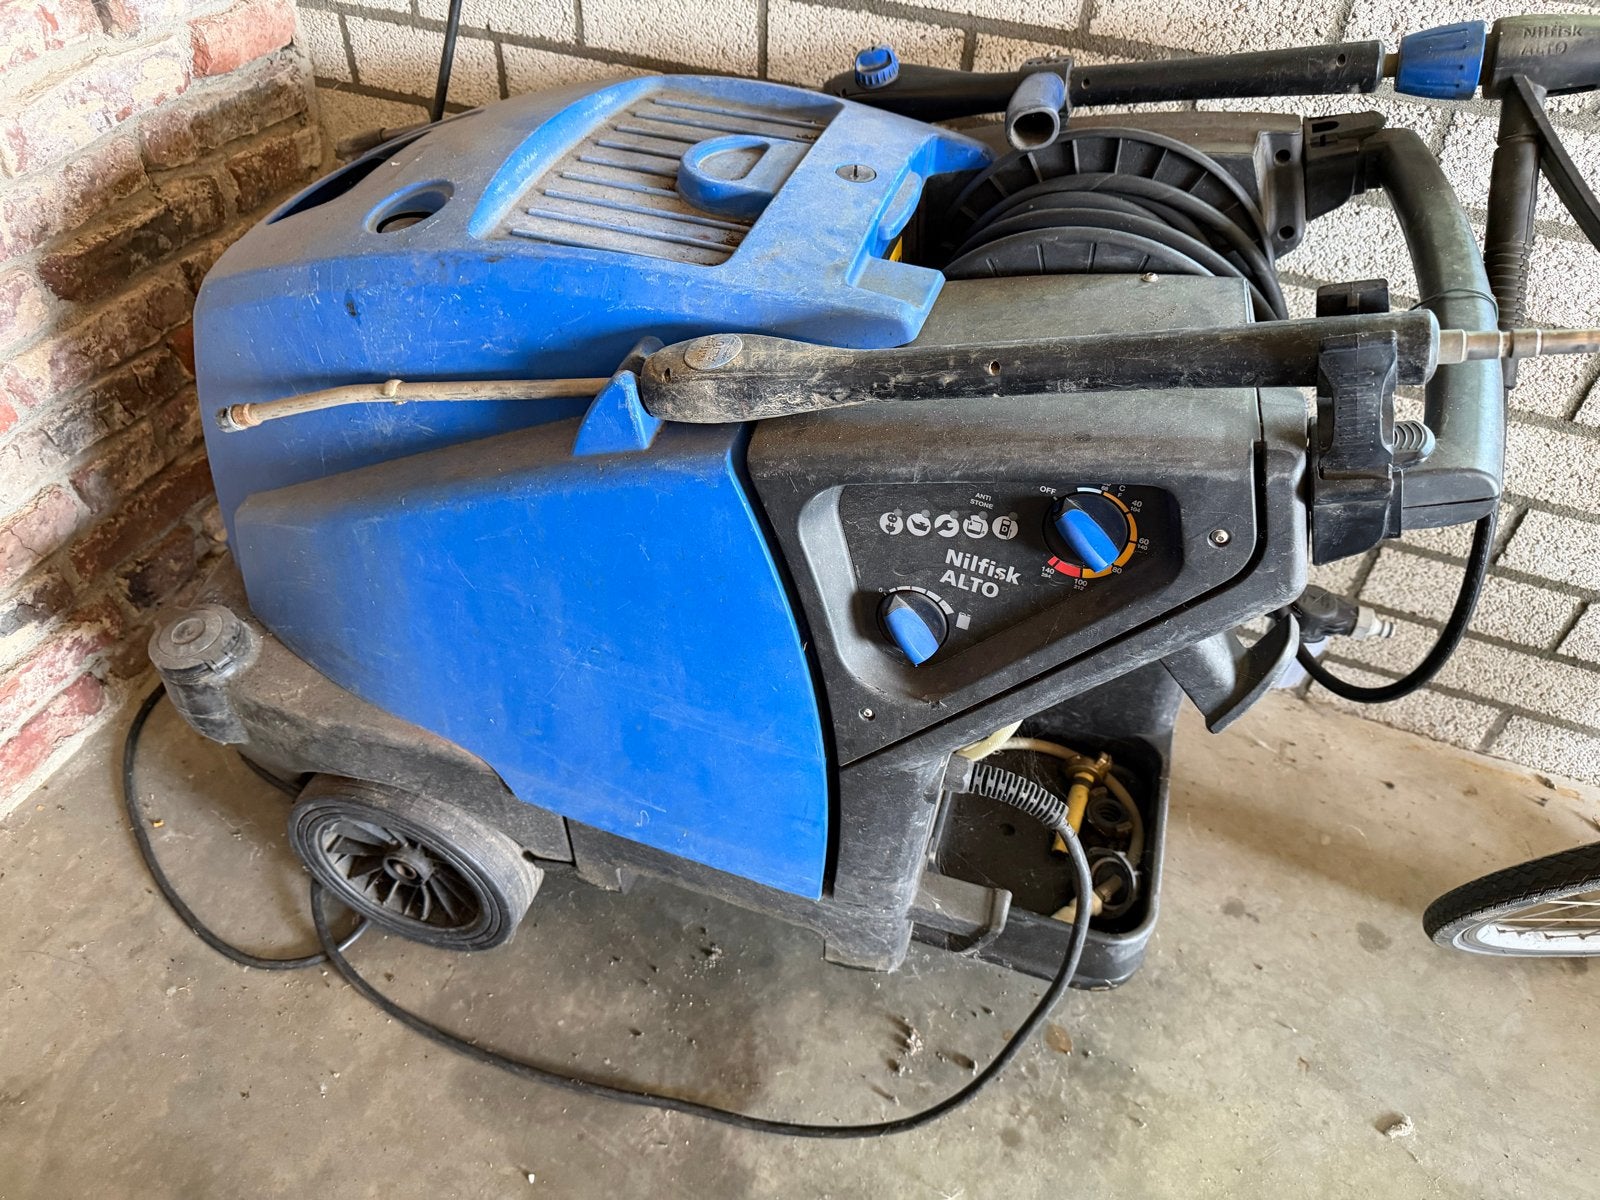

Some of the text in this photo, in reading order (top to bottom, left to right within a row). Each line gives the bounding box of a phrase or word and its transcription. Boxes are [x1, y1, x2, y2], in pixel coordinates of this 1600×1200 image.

[1039, 485, 1057, 495] OFF
[974, 492, 992, 501] ANTI
[969, 498, 994, 510] STONE
[1131, 499, 1143, 508] 40
[1138, 537, 1150, 547] 60
[945, 548, 1021, 585] Nilfisk
[1041, 566, 1055, 575] 140
[1111, 566, 1123, 575] 80
[939, 569, 999, 598] ALTO
[1074, 578, 1088, 587] 100
